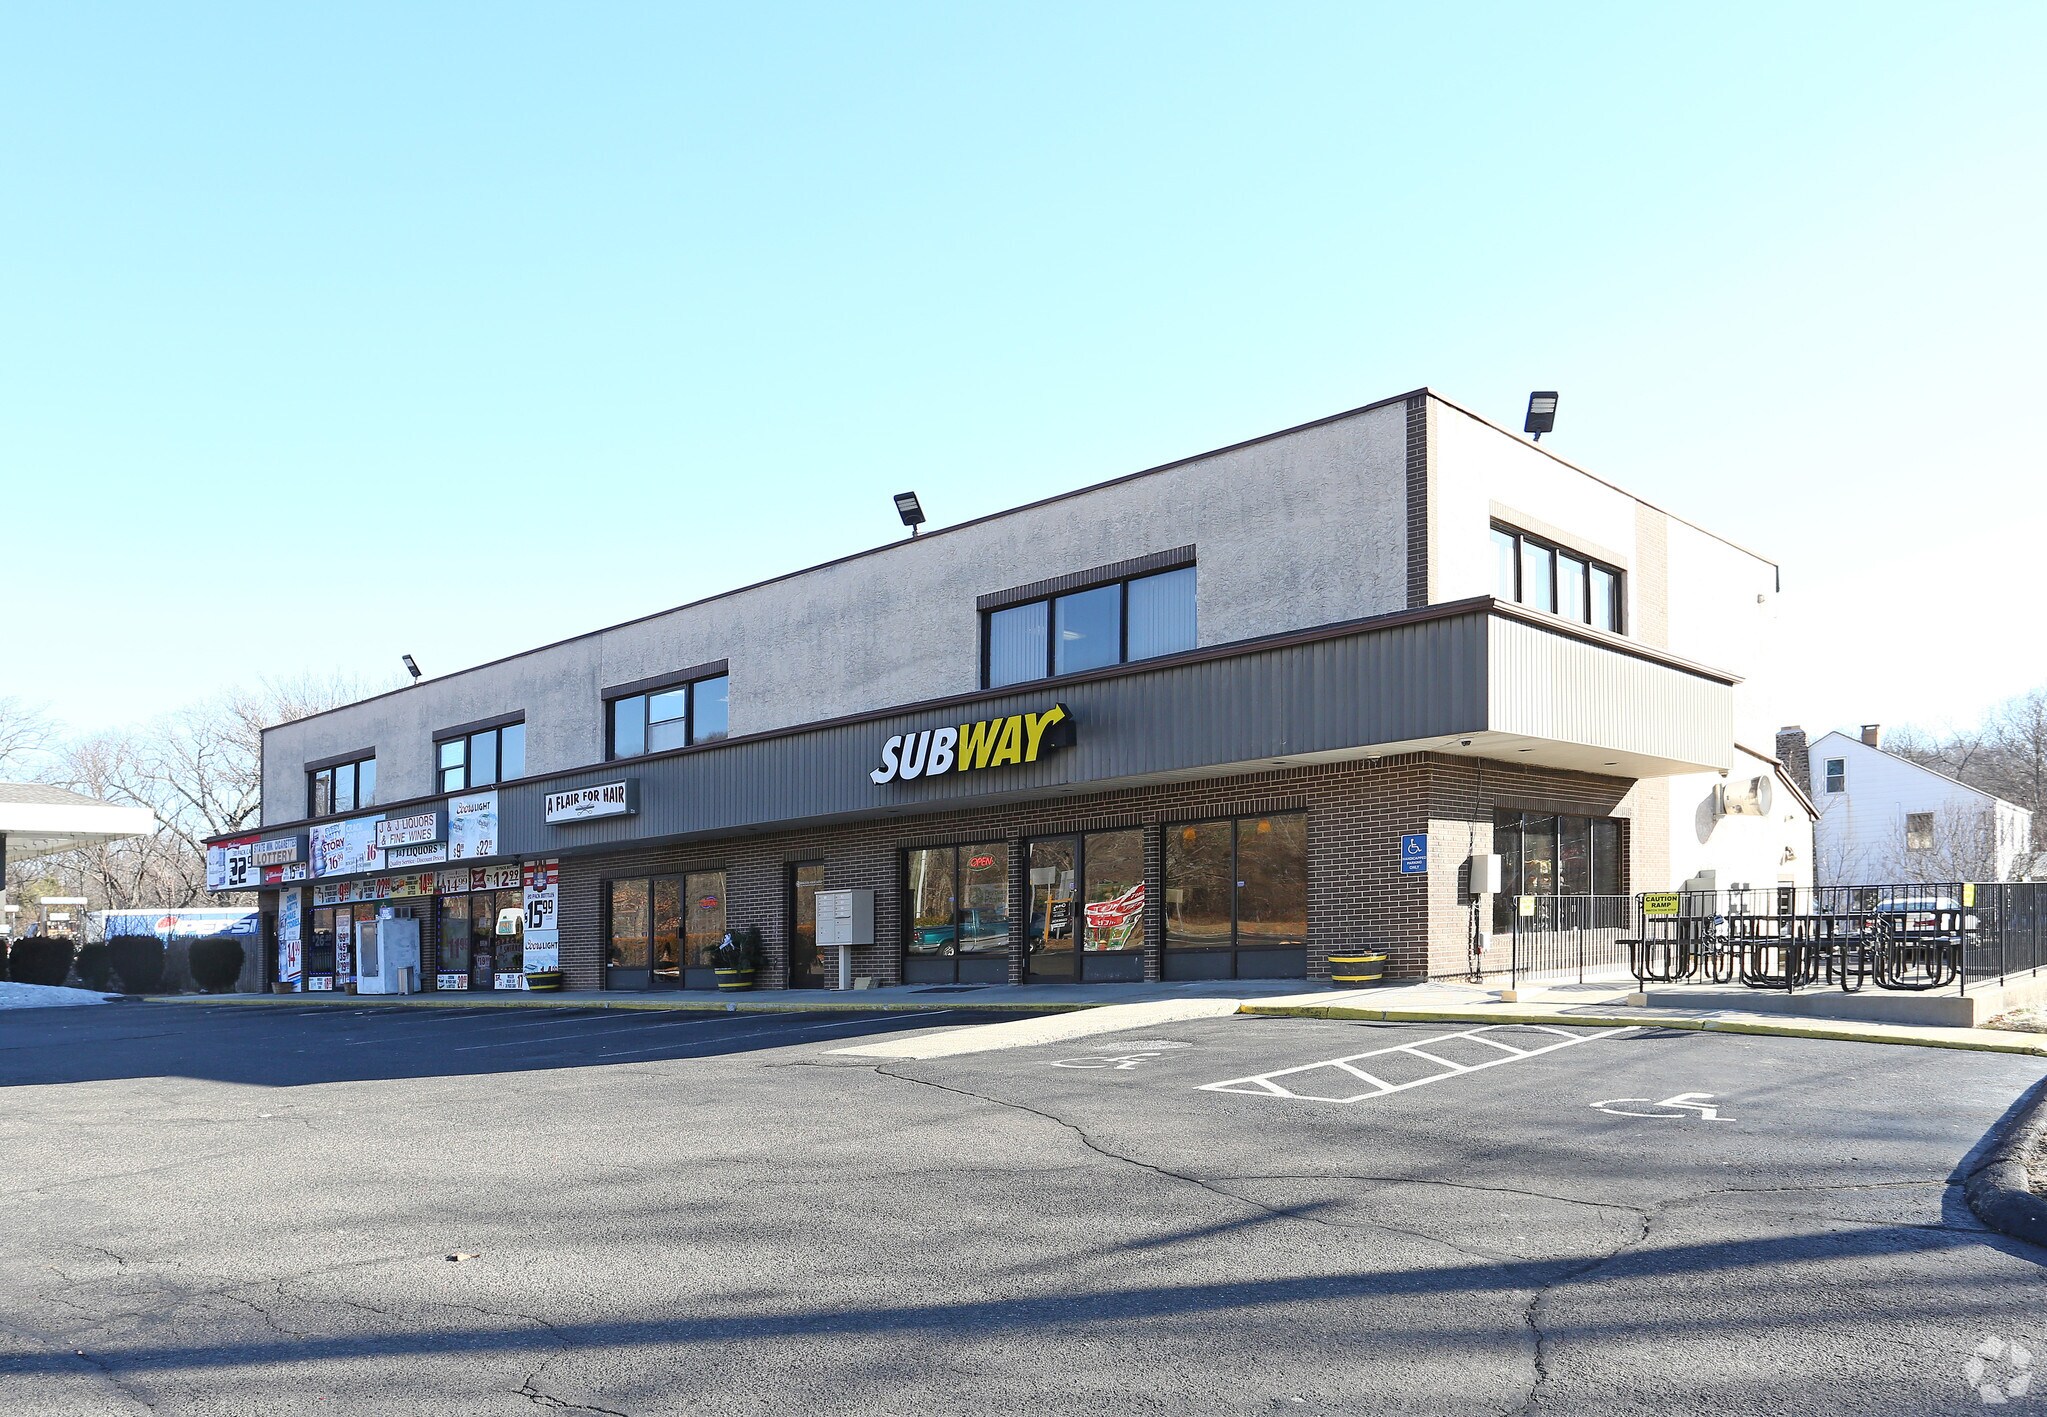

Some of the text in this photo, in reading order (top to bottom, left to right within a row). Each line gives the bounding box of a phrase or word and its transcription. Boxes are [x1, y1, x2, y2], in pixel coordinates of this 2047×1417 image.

[869, 703, 1065, 785] SUBWAY
[474, 802, 490, 812] LIGHT
[547, 785, 624, 816] A FLAIR FOR HAIR
[387, 822, 391, 831] &
[402, 815, 433, 829] LIQUORS
[382, 835, 386, 845] &
[390, 833, 405, 844] FINE
[409, 829, 431, 841] WINES
[253, 844, 266, 854] STATE
[322, 838, 344, 853] STORY
[406, 844, 437, 857] LIQUORS
[257, 849, 293, 864] LOTTERY
[970, 856, 993, 867] OPEN
[542, 942, 558, 951] LIGHT
